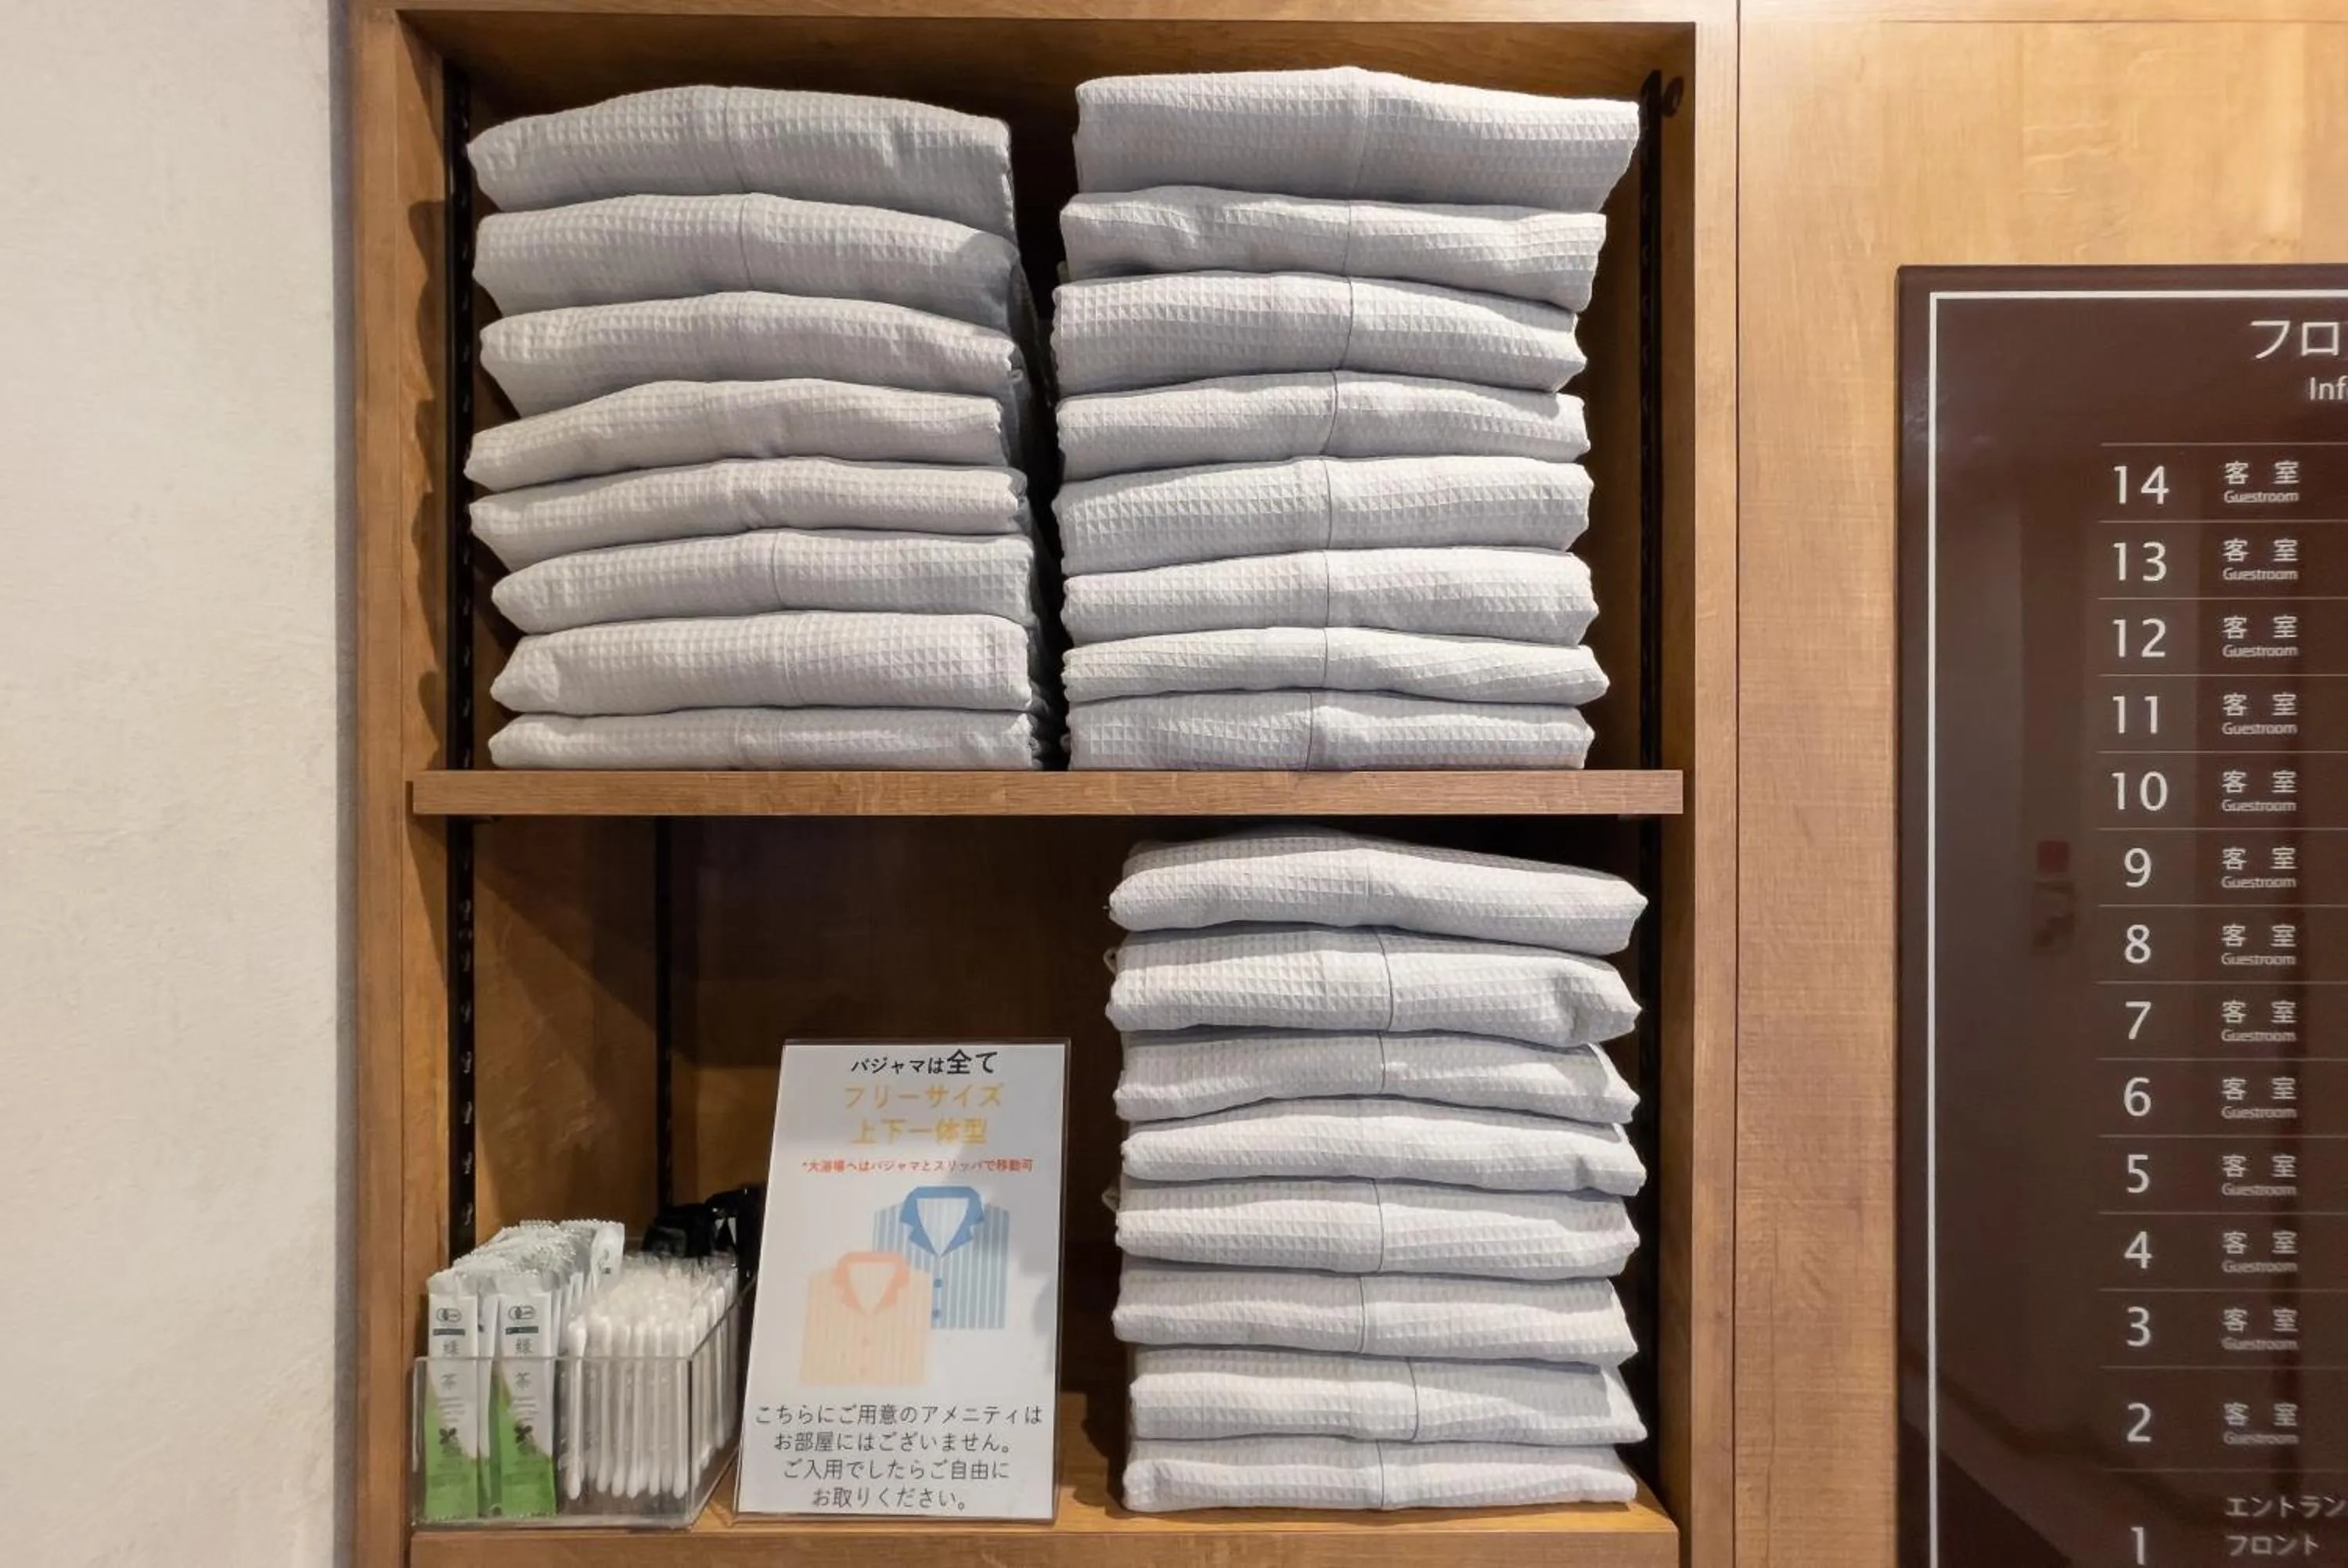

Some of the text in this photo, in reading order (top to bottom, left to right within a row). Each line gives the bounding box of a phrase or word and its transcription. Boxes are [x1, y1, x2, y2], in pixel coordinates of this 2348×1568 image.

[2310, 376, 2348, 401] Inf
[2114, 466, 2170, 504] 14
[2224, 490, 2300, 504] Guestroom
[2113, 541, 2167, 581] 13
[2223, 567, 2299, 581] Guestroom
[2113, 618, 2166, 658] 12
[2222, 644, 2299, 658] Guestroom
[2112, 696, 2159, 734] 11
[2221, 721, 2298, 735] Guestroom
[2112, 771, 2169, 811] 10
[2221, 798, 2297, 812] Guestroom
[2123, 848, 2152, 887] 9
[2221, 876, 2297, 889] Guestroom
[2124, 925, 2151, 964] 8
[2221, 952, 2296, 966] Guestroom
[2126, 1002, 2152, 1040] 7
[2221, 1028, 2297, 1042] Guestroom
[844, 1082, 1005, 1109] フリーサイズ
[2123, 1077, 2152, 1117] 6
[2221, 1106, 2297, 1119] Guestroom
[849, 1117, 989, 1145] 上下一体型
[2126, 1154, 2150, 1193] 5
[2221, 1182, 2297, 1196] Guestroom
[2124, 1232, 2152, 1269] 4
[2221, 1259, 2298, 1274] Guestroom
[2126, 1307, 2151, 1347] 3
[2221, 1336, 2298, 1350] Guestroom
[754, 1404, 1043, 1426] こちらにご用意のアメニティは
[2127, 1402, 2152, 1443] 2
[773, 1431, 1011, 1454] お部屋にはございません。
[2224, 1430, 2299, 1445] Guestroom
[783, 1458, 1010, 1480] ご入用でしたらご自由に
[812, 1486, 966, 1512] お取りください。
[2130, 1527, 2145, 1566] 1
[2226, 1534, 2319, 1557] フロント
